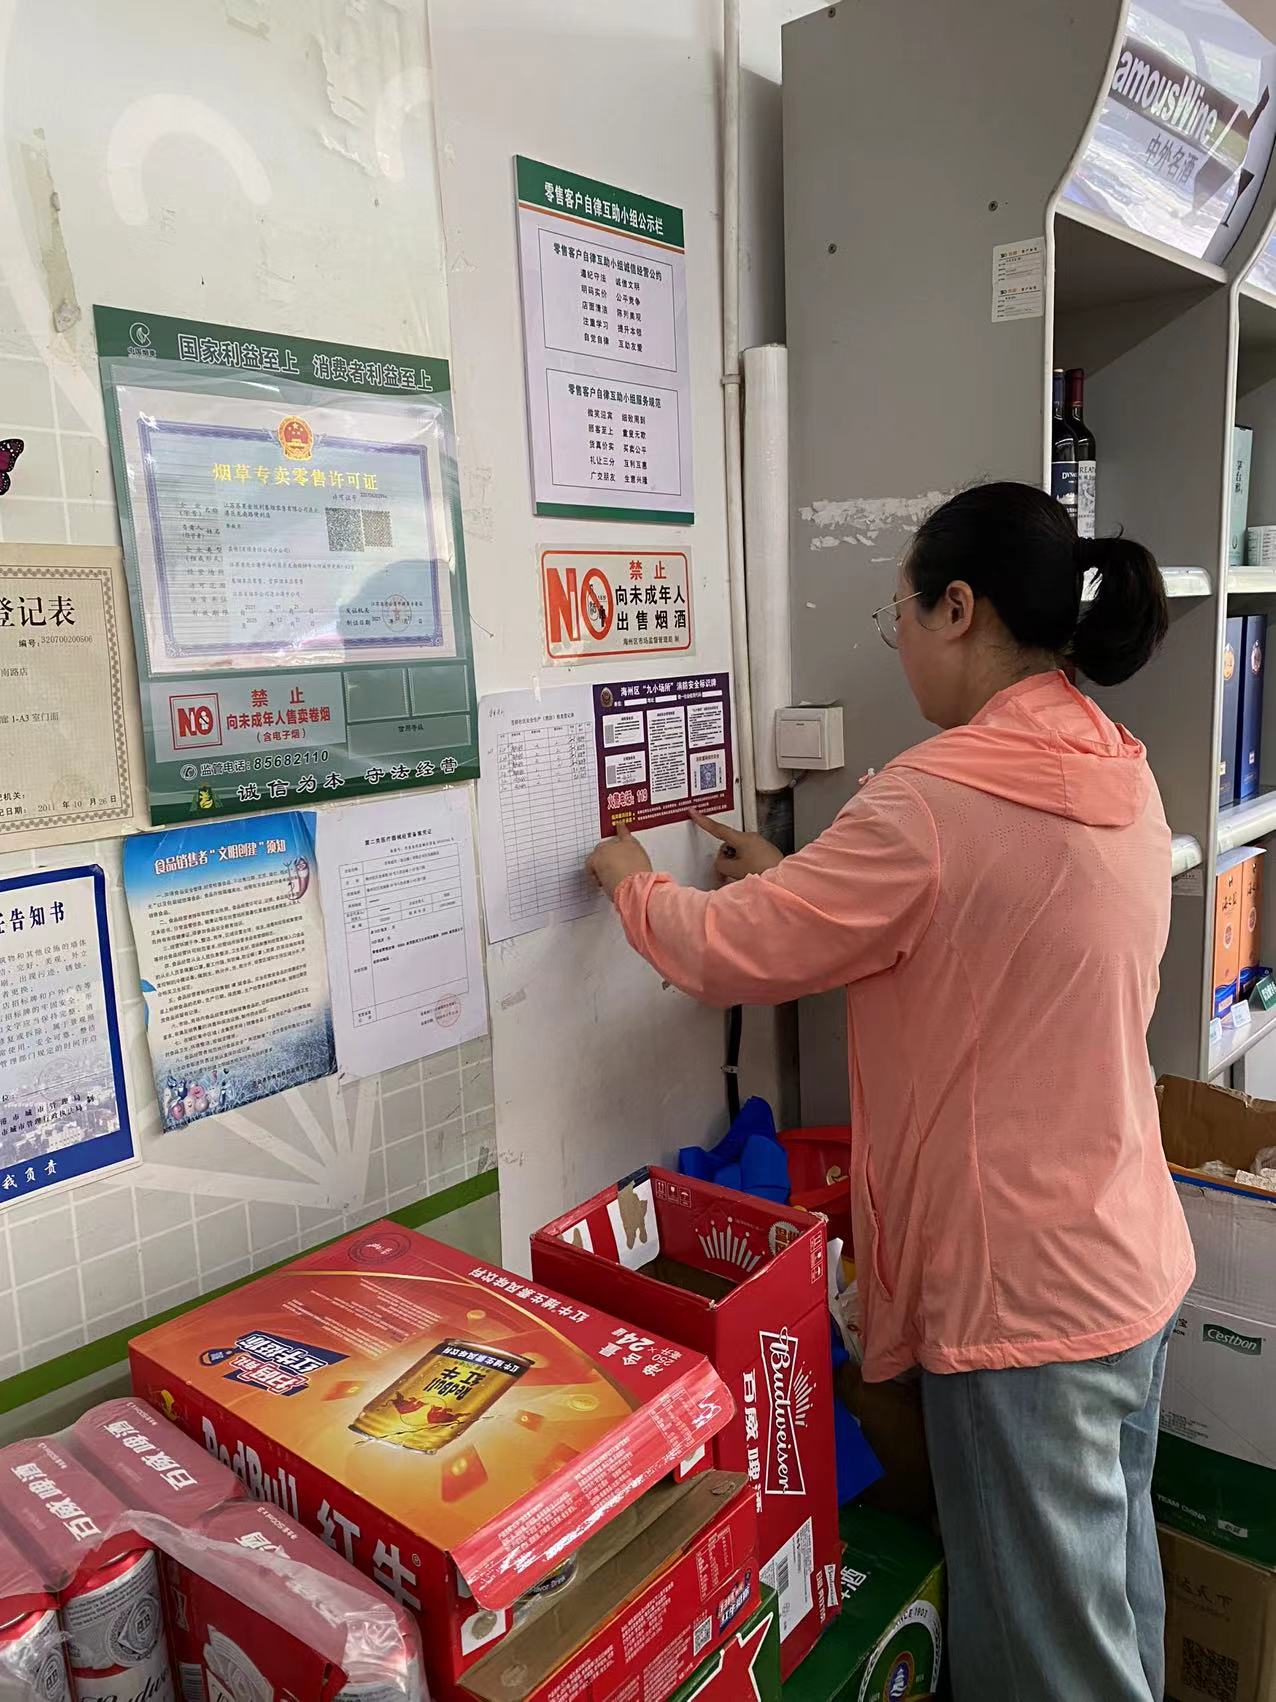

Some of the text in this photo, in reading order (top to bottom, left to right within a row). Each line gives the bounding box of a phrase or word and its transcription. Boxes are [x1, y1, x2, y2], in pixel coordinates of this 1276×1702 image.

[1148, 133, 1198, 185] 中外名酒
[544, 181, 664, 236] 零售客户自律互助小组公示栏
[553, 243, 662, 281] 零售客户自律互助小组诚信经营公约
[580, 269, 640, 291] 遵纪守法 诚信文明
[581, 285, 641, 306] 明码实价 公平竞争
[583, 317, 609, 330] 注重学习
[584, 333, 643, 352] 自觉自律 互助友爱
[177, 334, 433, 393] 国家利益至上 消费者利益至上
[568, 384, 662, 409] 零售客户自律互助小组服务规范
[588, 424, 614, 436] 顾客至上
[589, 440, 615, 451] 货真价实
[590, 456, 615, 466] 礼让三分
[212, 463, 378, 490] 烟草专卖零售许可证
[590, 472, 616, 482] 广交朋友
[629, 560, 667, 580] 禁止
[546, 568, 614, 642] NO
[615, 585, 685, 606] 向未成年人
[617, 609, 686, 631] 出售烟酒
[251, 687, 305, 708] 禁止
[178, 705, 214, 738] NO
[226, 706, 331, 730] 向未成年人售卖卷烟
[237, 757, 458, 802] 诚信为本 守法经营
[90, 798, 96, 806] 月
[110, 795, 117, 803] 日
[2, 1159, 57, 1189] 我负责
[469, 1266, 590, 1324] 红牛维生素风味饮料
[599, 1342, 664, 1376] 净含量
[440, 1366, 486, 1386] 红牛
[423, 1378, 473, 1400] RedBull
[770, 1326, 791, 1494] Budweiser
[103, 1420, 198, 1491] 百威啤酒
[10, 1462, 101, 1542] 百威啤酒
[317, 1498, 421, 1611] 红牛
[914, 1607, 928, 1618] 1903
